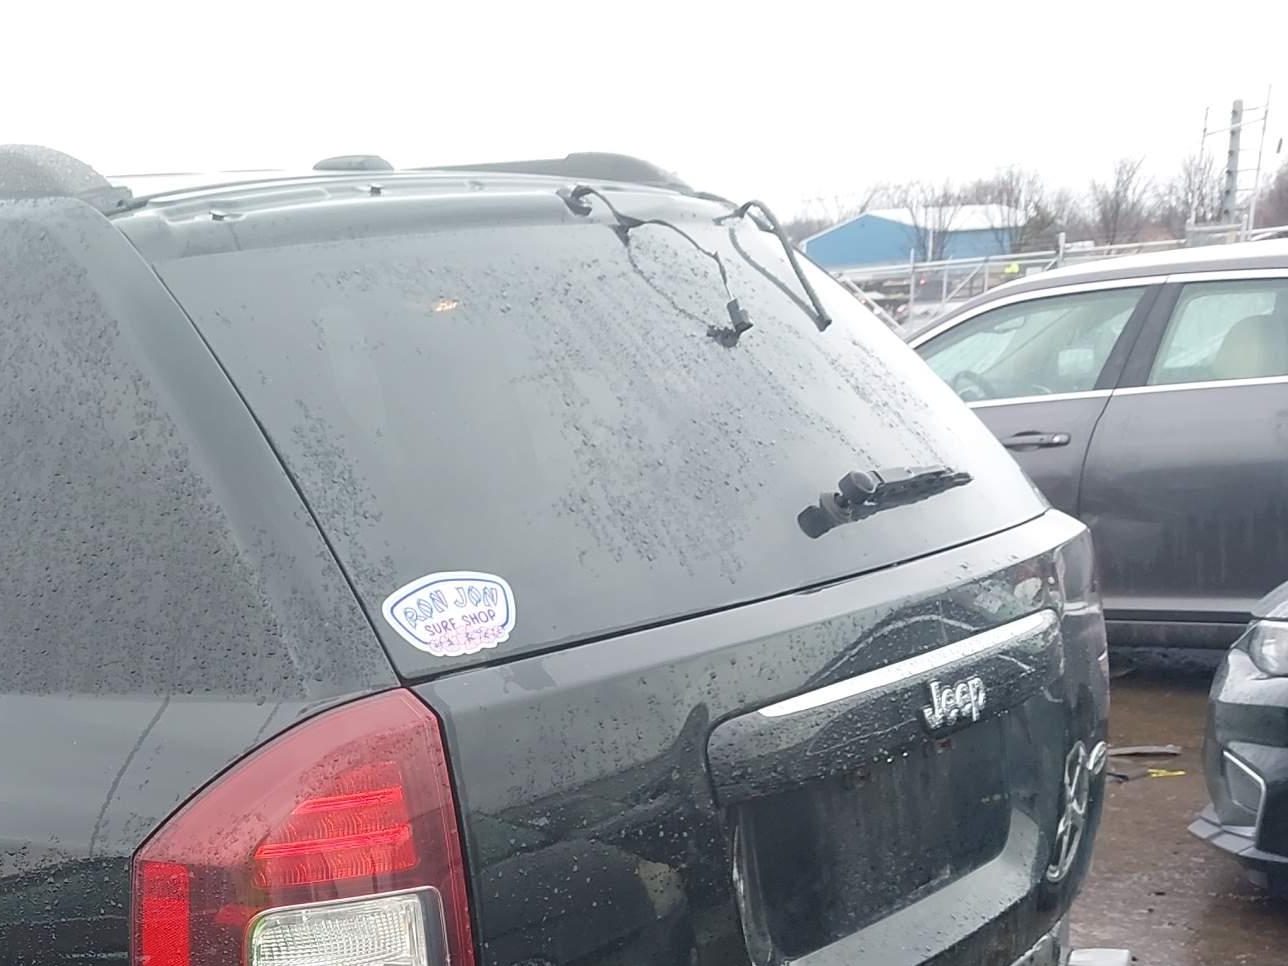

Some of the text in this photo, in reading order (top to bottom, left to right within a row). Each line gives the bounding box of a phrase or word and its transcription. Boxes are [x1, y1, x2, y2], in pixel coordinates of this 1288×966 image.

[404, 585, 498, 629] RON JON
[424, 608, 496, 636] SURF SHOP
[922, 677, 987, 729] Jeep
